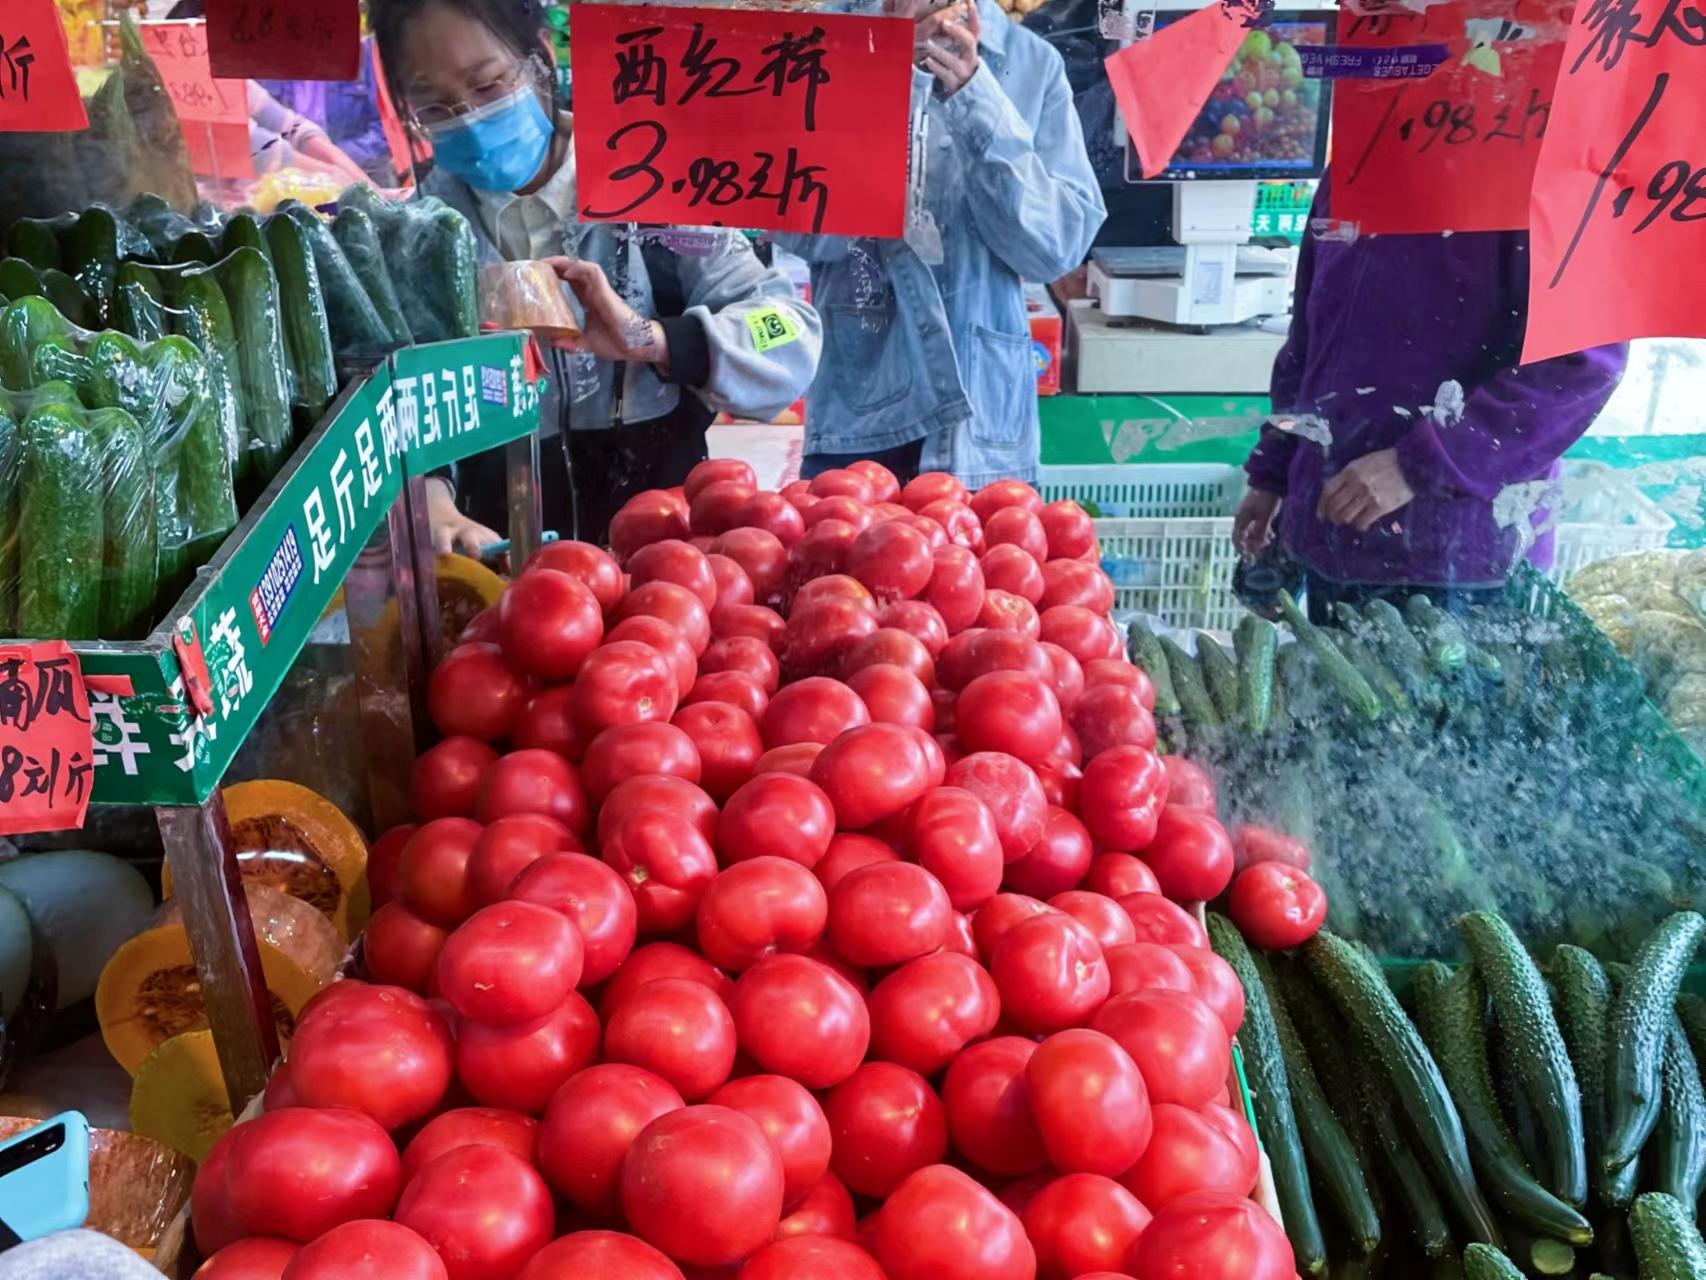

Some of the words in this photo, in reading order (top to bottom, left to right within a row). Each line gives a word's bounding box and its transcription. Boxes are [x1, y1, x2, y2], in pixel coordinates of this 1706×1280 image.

[613, 22, 831, 131] 西红柿
[582, 120, 828, 233] 3.98元/斤
[303, 386, 400, 584] 足斤足两
